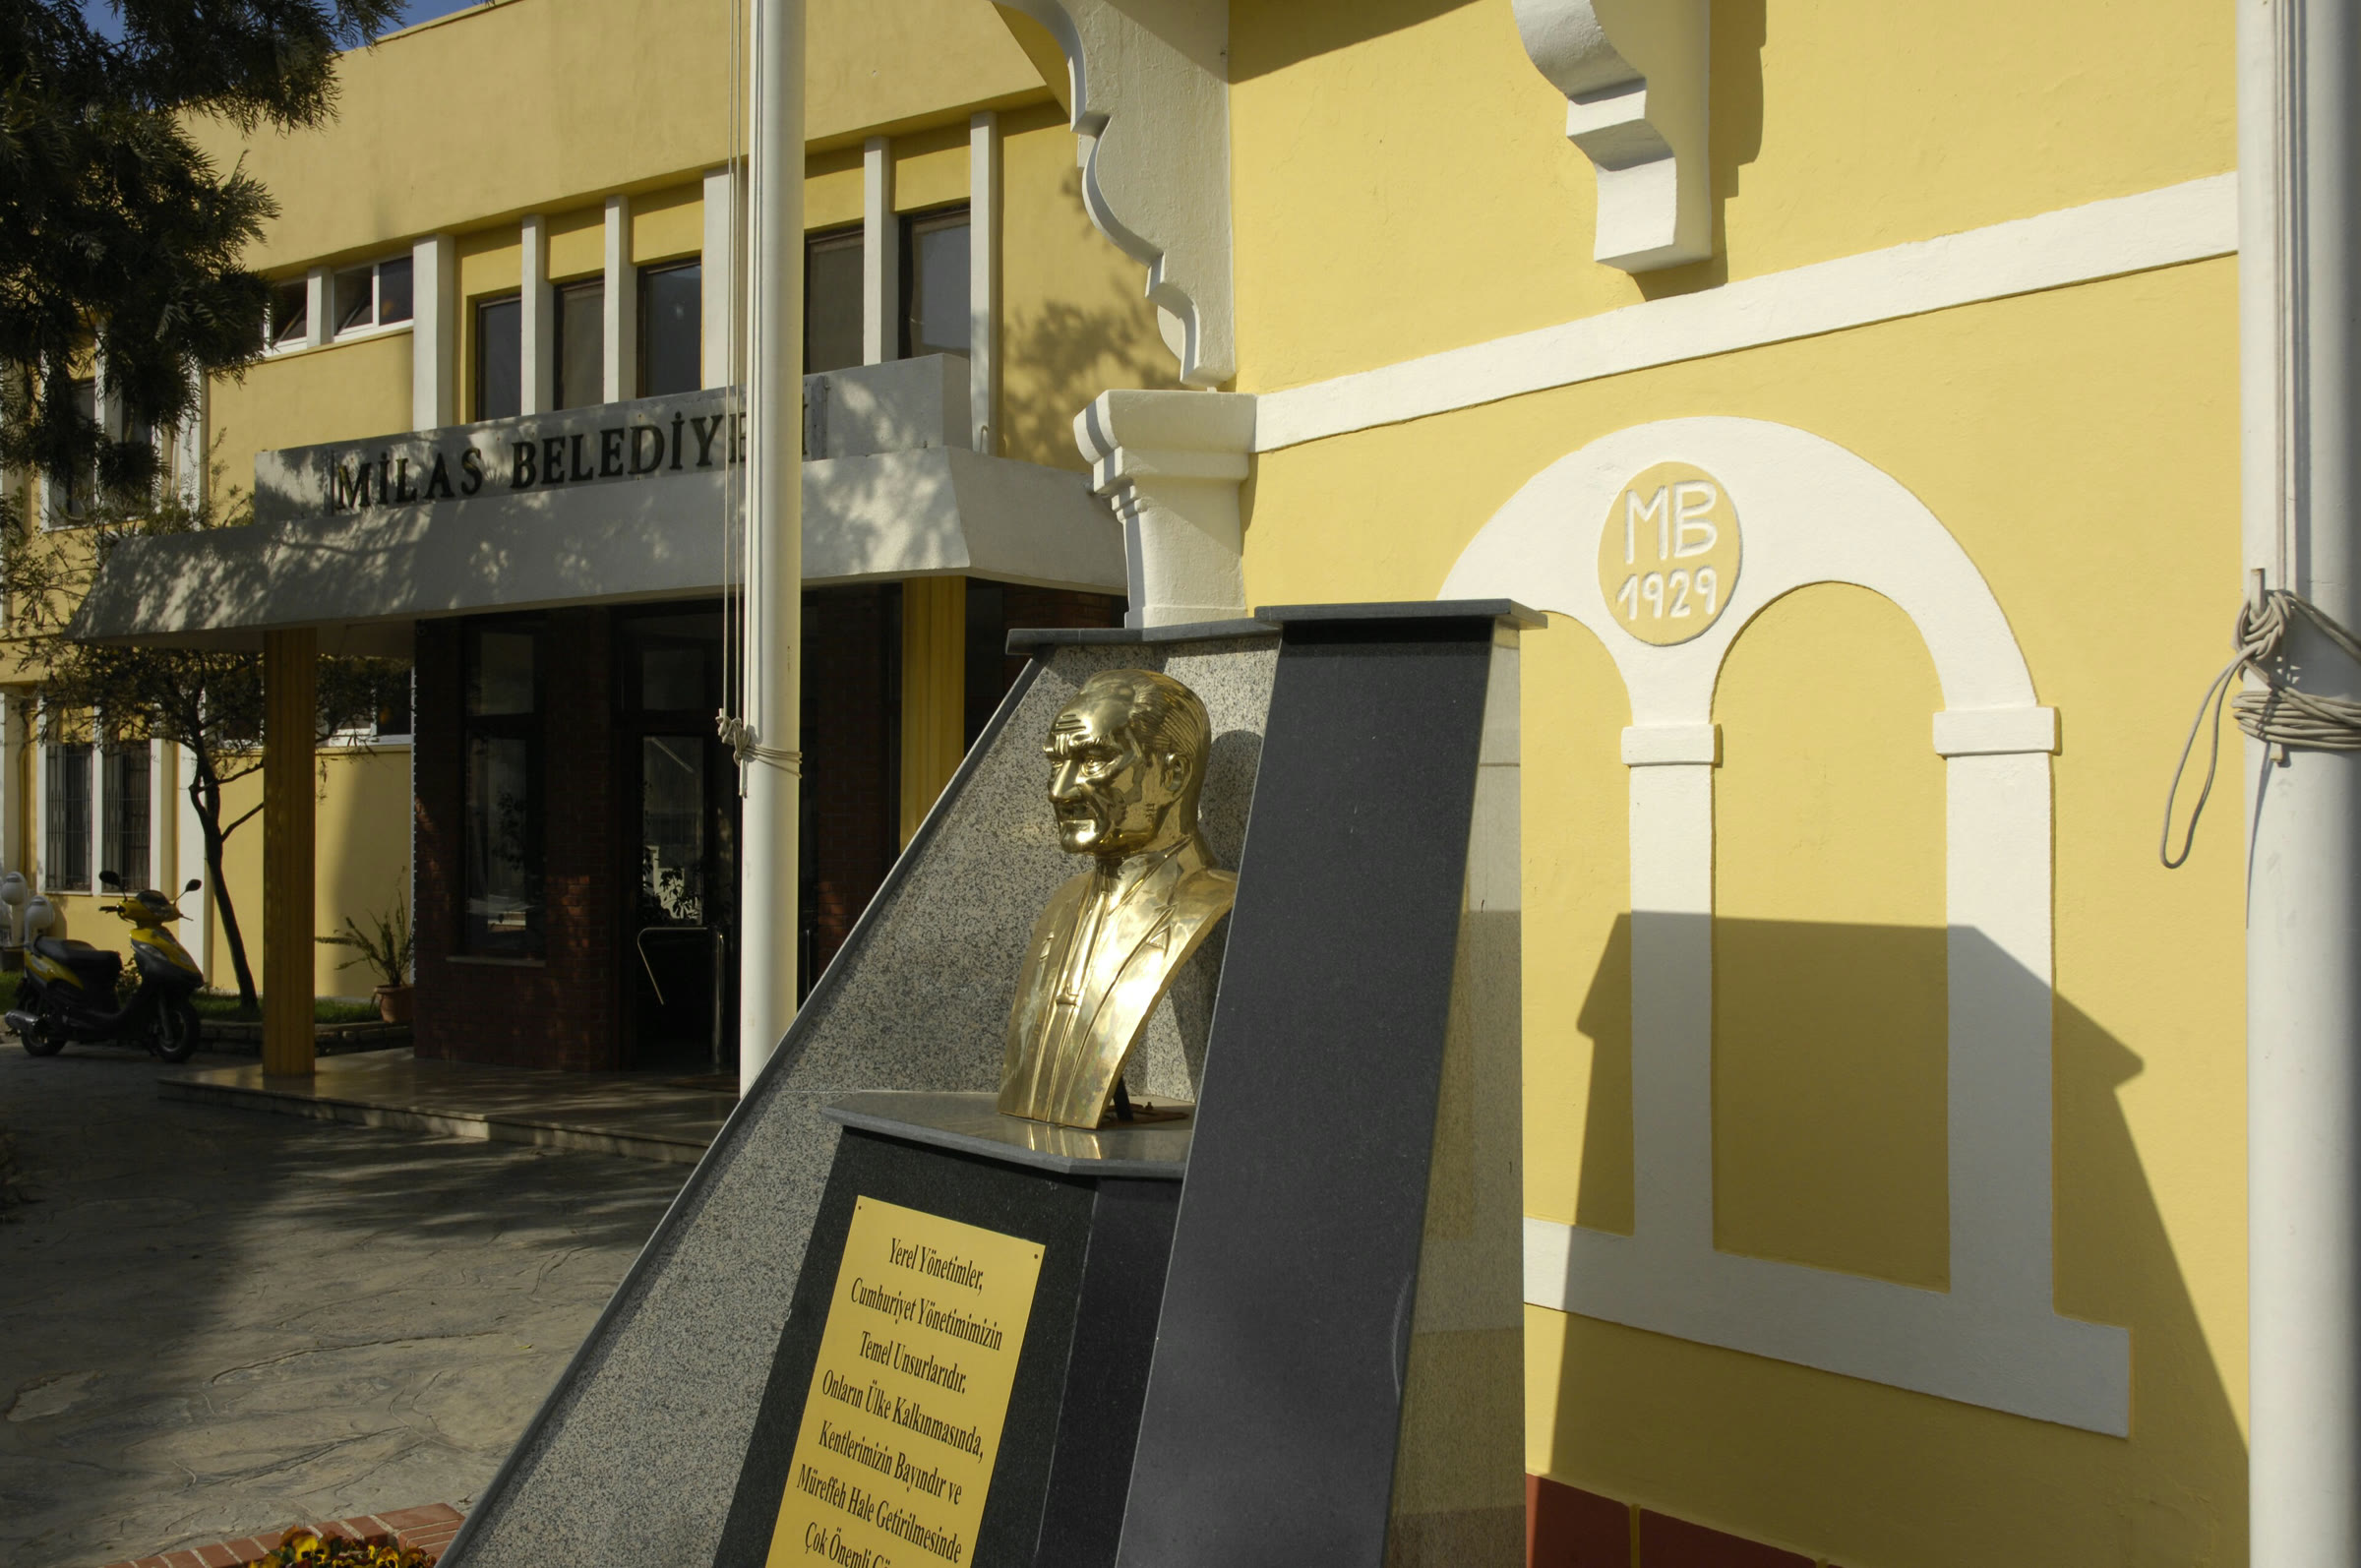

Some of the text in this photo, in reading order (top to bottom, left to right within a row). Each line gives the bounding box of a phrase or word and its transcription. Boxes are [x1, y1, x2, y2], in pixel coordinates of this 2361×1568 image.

[336, 394, 808, 511] MİLAS BELEDİYE
[1625, 479, 1718, 565] MB
[1616, 566, 1718, 621] 1929
[888, 1237, 984, 1296] Yerel Yönetimler,
[850, 1277, 1003, 1351] Cumhuriyet Yönetimimizin
[859, 1330, 966, 1394] Temel Unsurlarıdır.
[822, 1369, 984, 1464] Onların Ülke Kalkınmasında,
[818, 1419, 962, 1505] Kentlerimizin Bayındır ve
[796, 1463, 962, 1563] Müreffeh Hale Getirilmesinde
[805, 1521, 872, 1568] Çok Önemli
